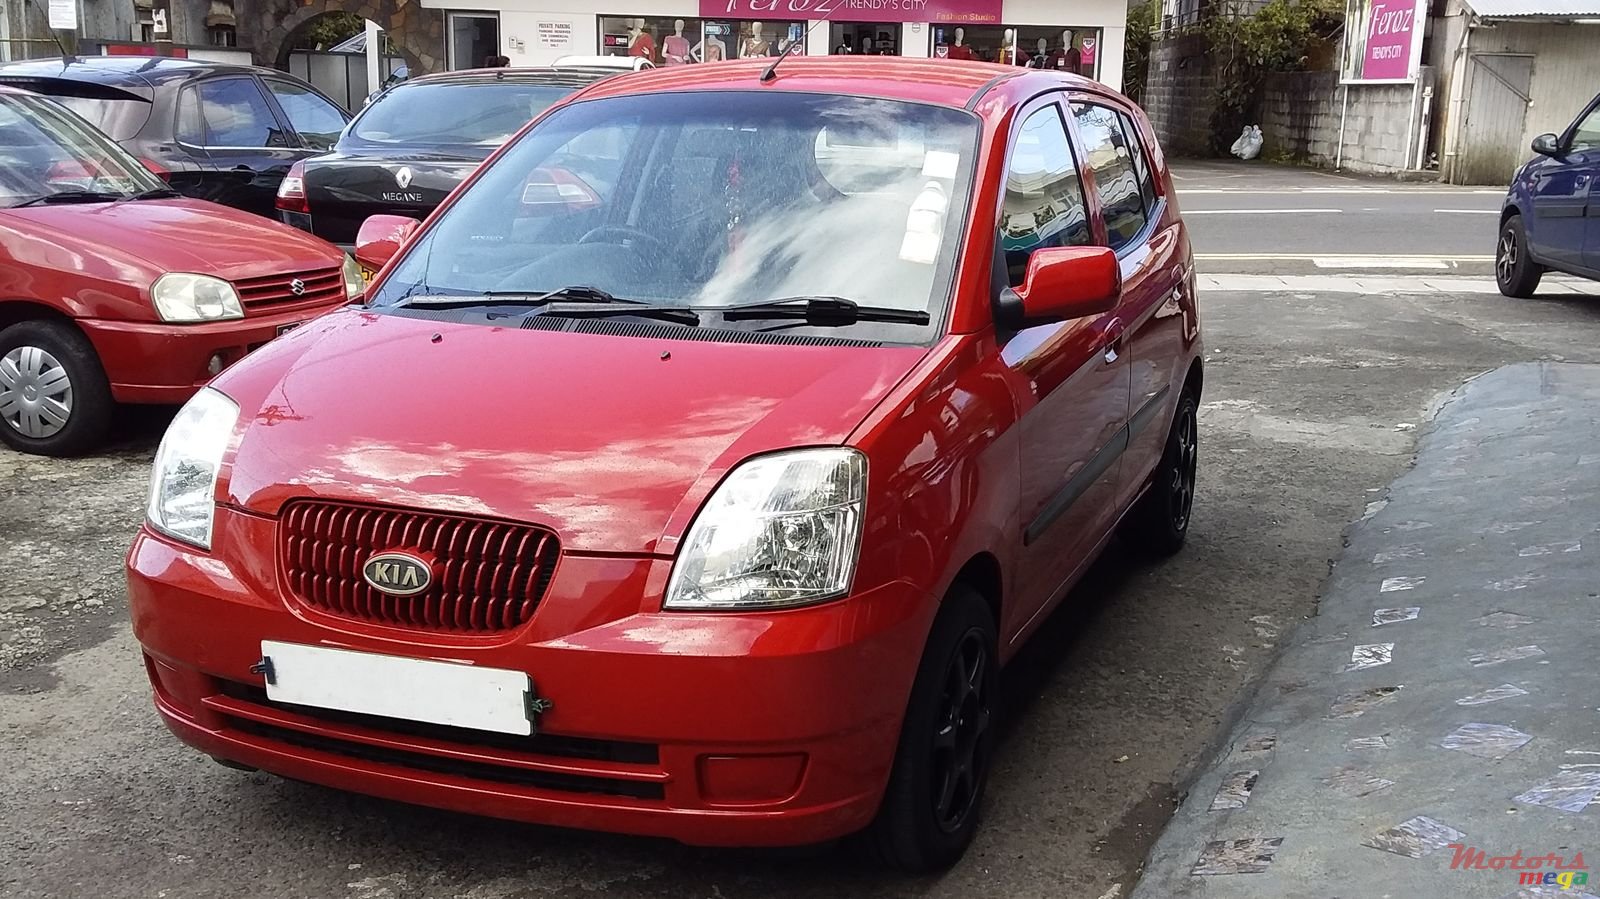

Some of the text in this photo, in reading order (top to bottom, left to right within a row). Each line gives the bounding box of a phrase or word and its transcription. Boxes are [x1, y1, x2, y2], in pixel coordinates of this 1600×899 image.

[901, 0, 928, 10] CITY
[969, 13, 996, 21] Studio
[1369, 4, 1414, 39] Feroz
[382, 192, 422, 202] MEGANE
[374, 562, 419, 587] KIA
